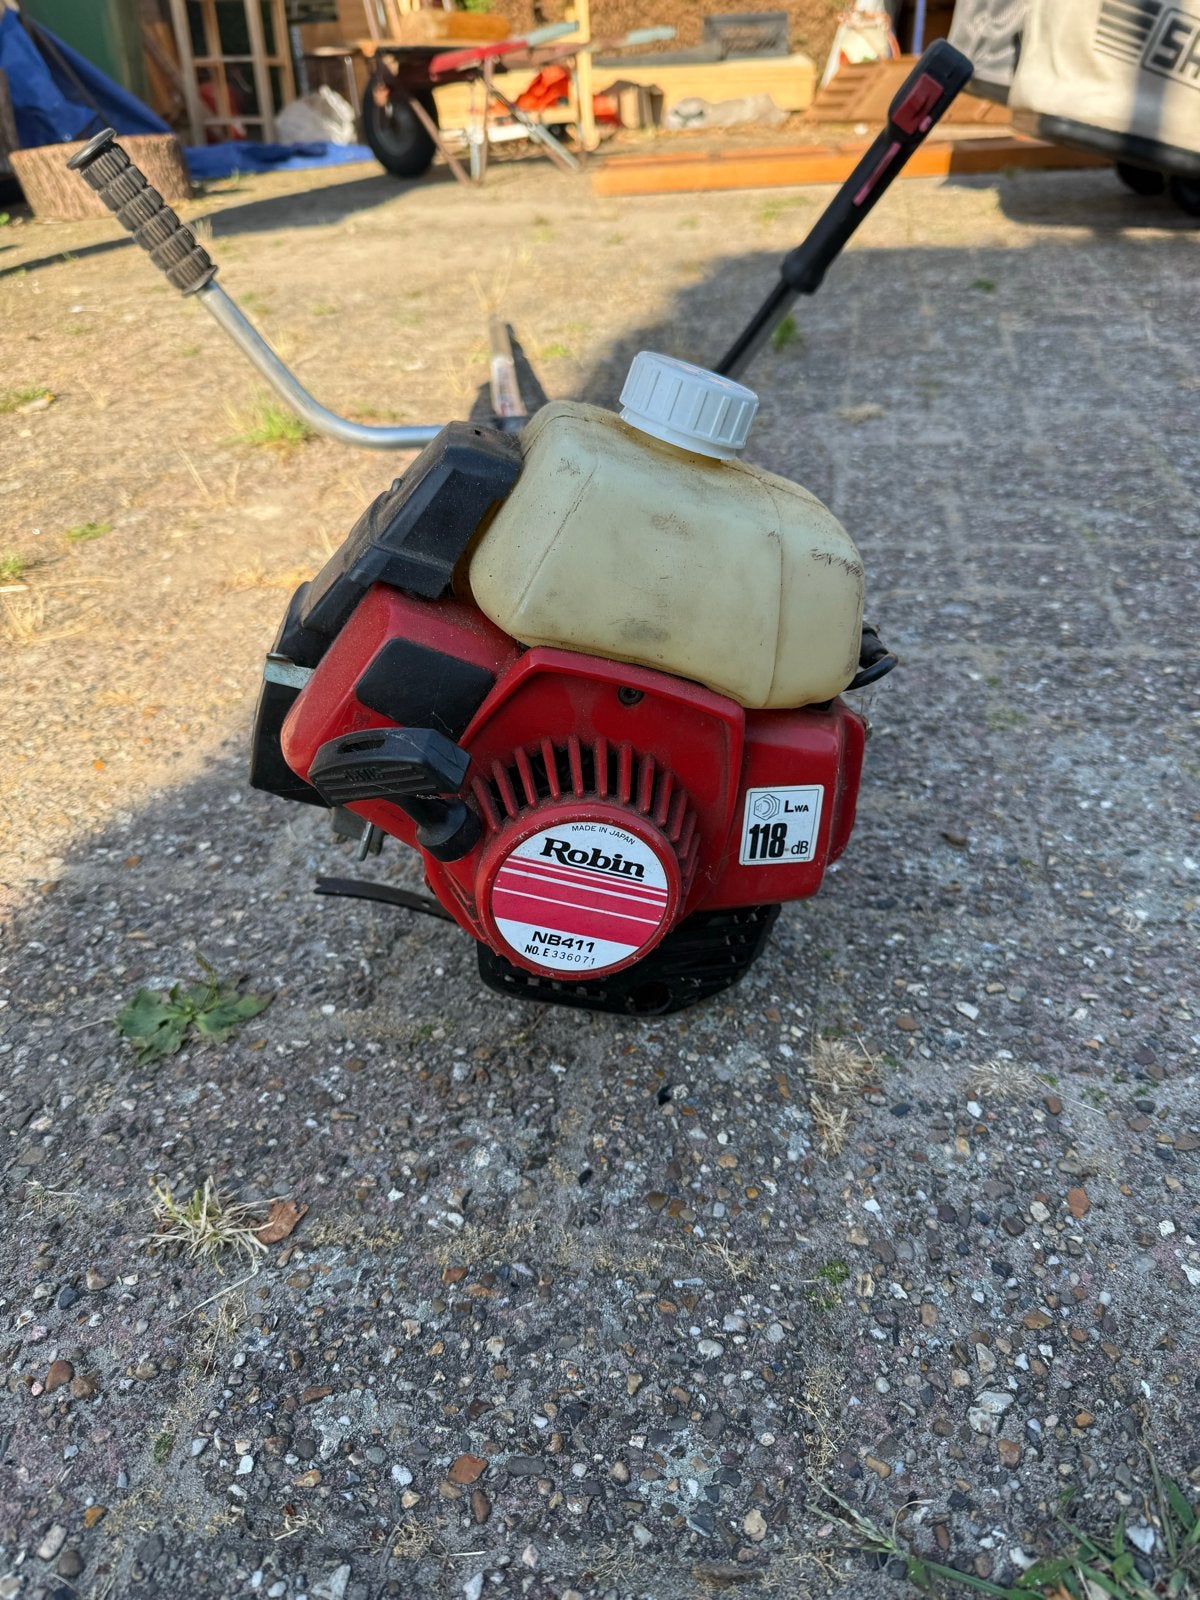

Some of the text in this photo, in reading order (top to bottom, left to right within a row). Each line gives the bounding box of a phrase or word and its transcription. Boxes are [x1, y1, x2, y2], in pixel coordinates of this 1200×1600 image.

[571, 824, 636, 845] MADE IN JAPAN
[749, 822, 809, 859] 118 dB
[539, 837, 645, 880] Robin
[531, 930, 595, 953] NB411
